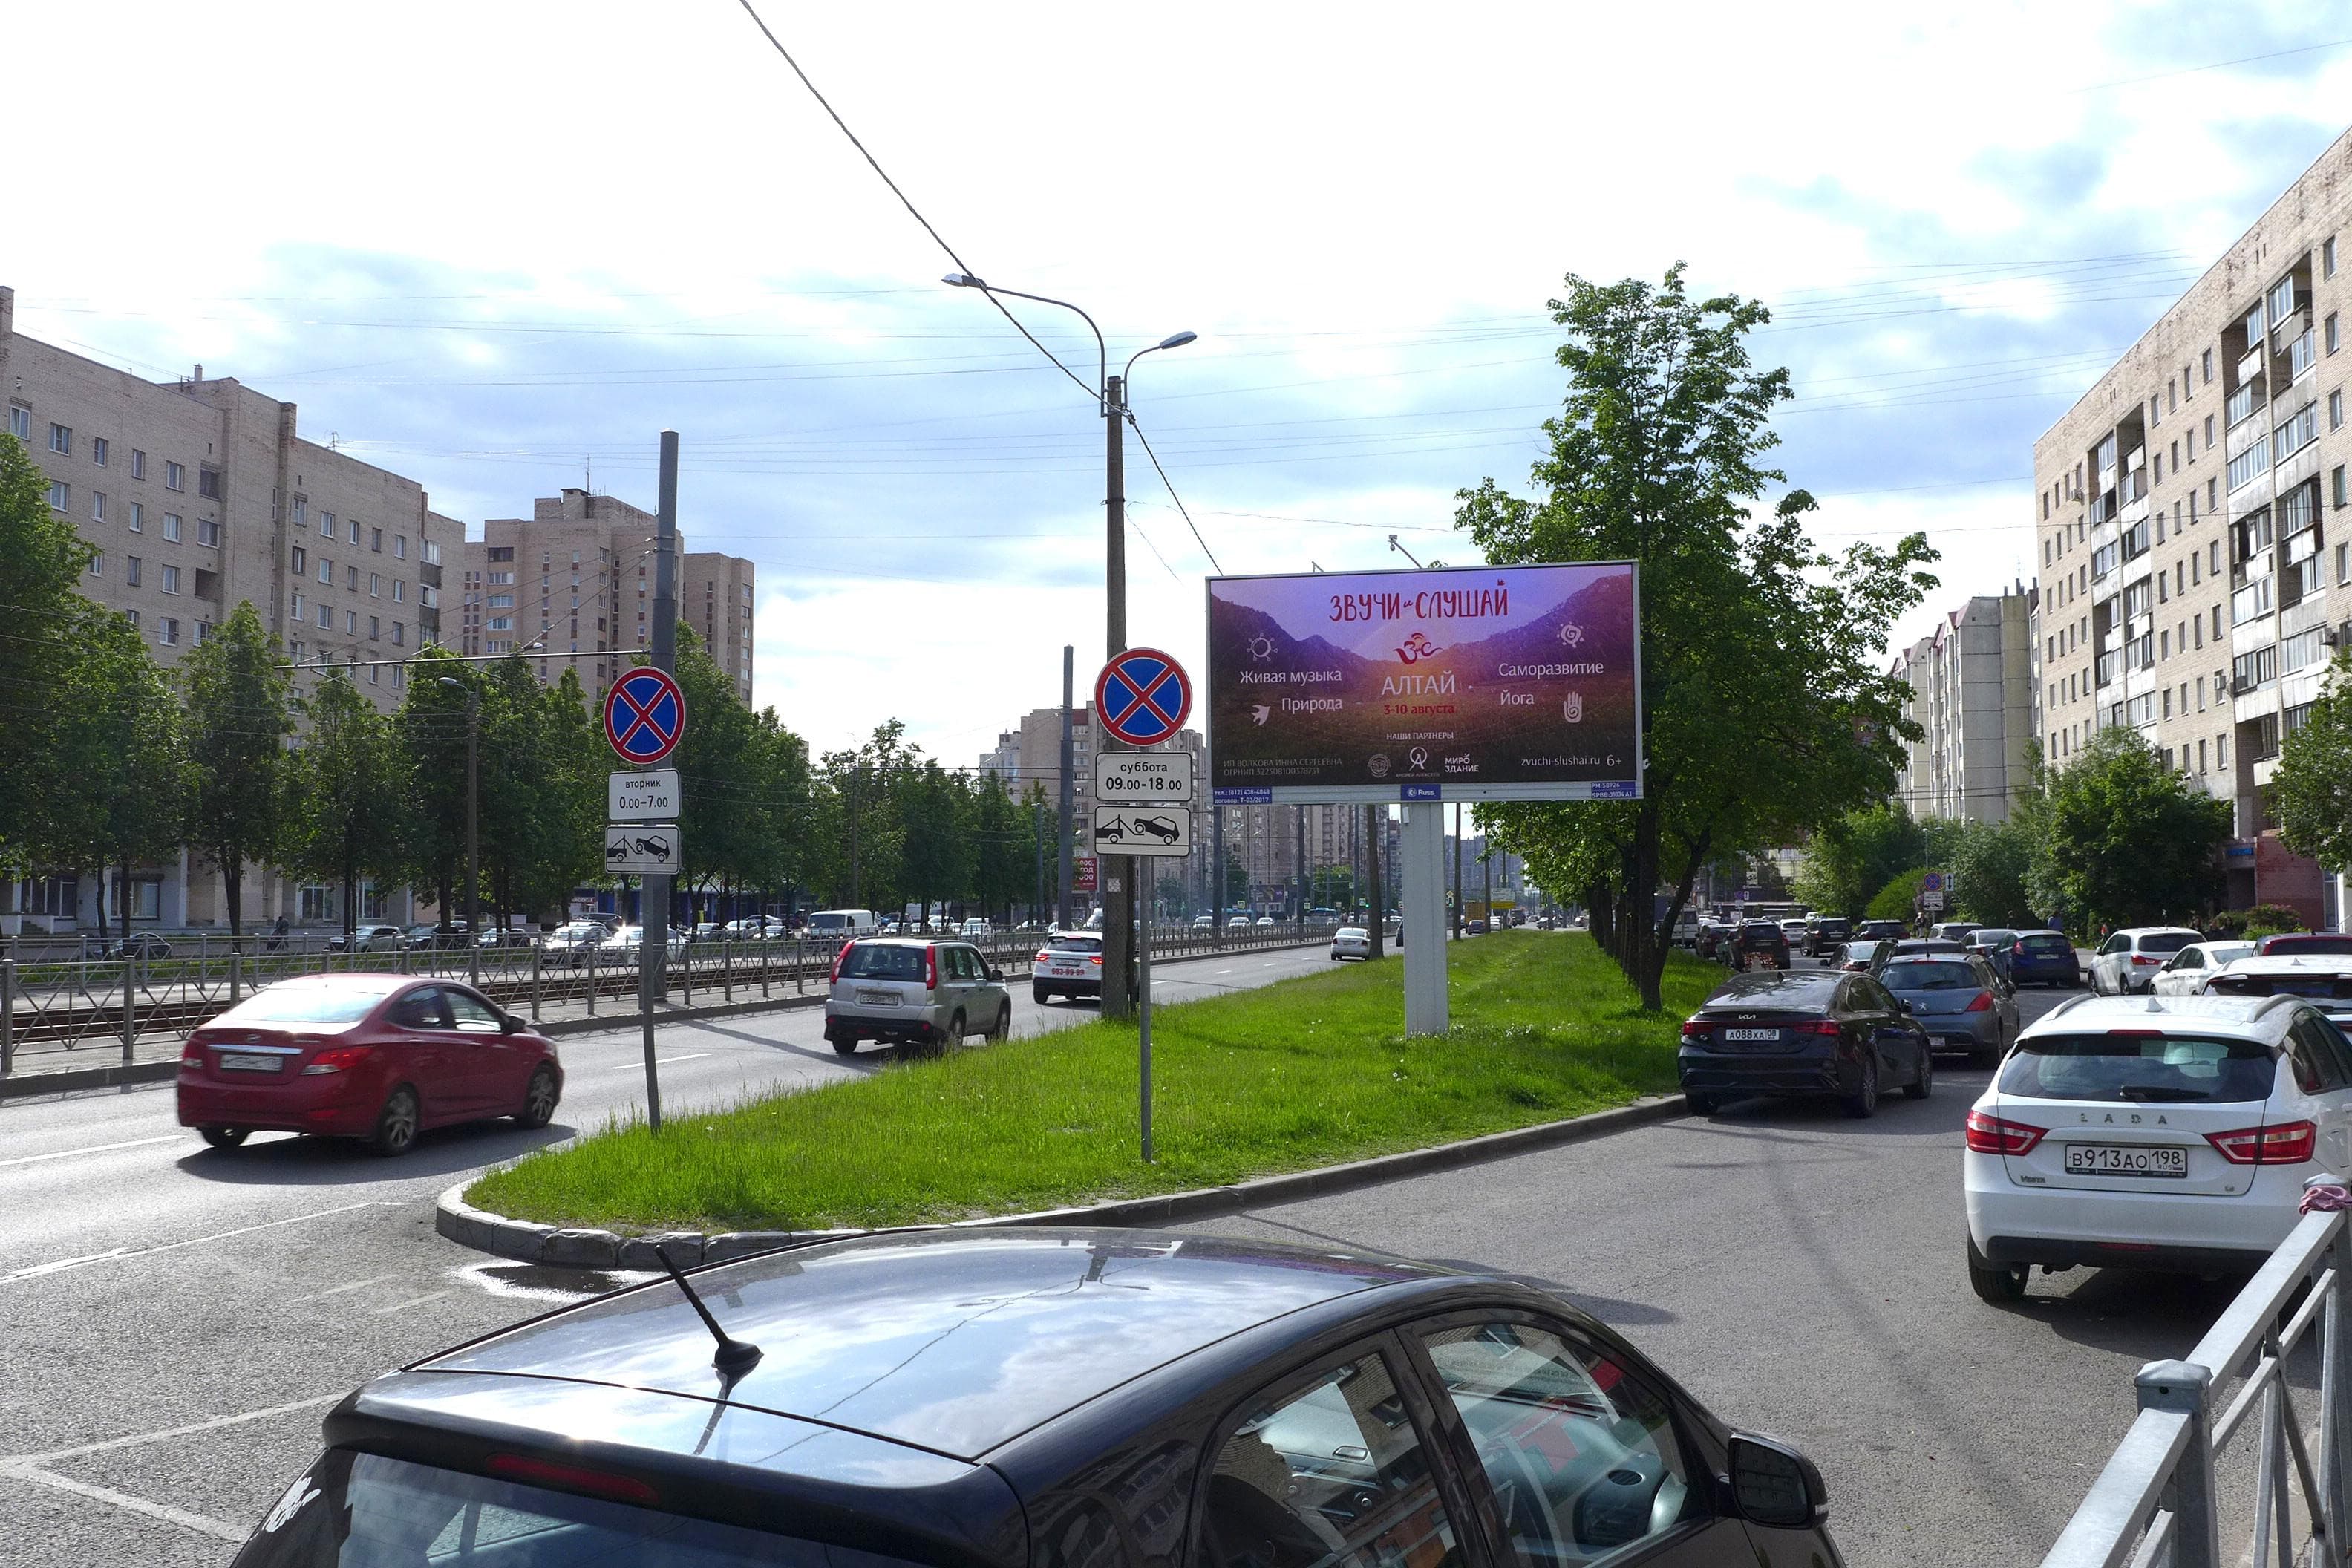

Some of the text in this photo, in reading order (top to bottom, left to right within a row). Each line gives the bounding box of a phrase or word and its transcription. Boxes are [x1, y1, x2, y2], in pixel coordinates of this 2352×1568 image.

[1330, 592, 1400, 621] ЗВУЧИ
[1415, 579, 1509, 619] СЛУШАЙ
[1498, 662, 1604, 679] Саморазвитие
[1240, 670, 1342, 686] Живая музыка
[1381, 670, 1455, 696] АЛТАЙ
[1500, 689, 1535, 705] Йога
[1281, 697, 1343, 714] Природа
[1383, 704, 1455, 716] 3-10 августа
[1386, 731, 1454, 740] НАШИ ПАРТНЕРЫ
[1237, 759, 1274, 768] ВОЛКОВА
[1275, 759, 1298, 767] ИННА
[1521, 754, 1622, 767] zvuchi-slushai.ru 6+
[1120, 762, 1168, 774] суббота
[1445, 765, 1479, 773] ЗДАНИЕ
[625, 780, 661, 790] вторник
[1105, 777, 1183, 791] 09.00-18.00
[2080, 1113, 2168, 1125] LADA
[2151, 1150, 2181, 1165] 198
